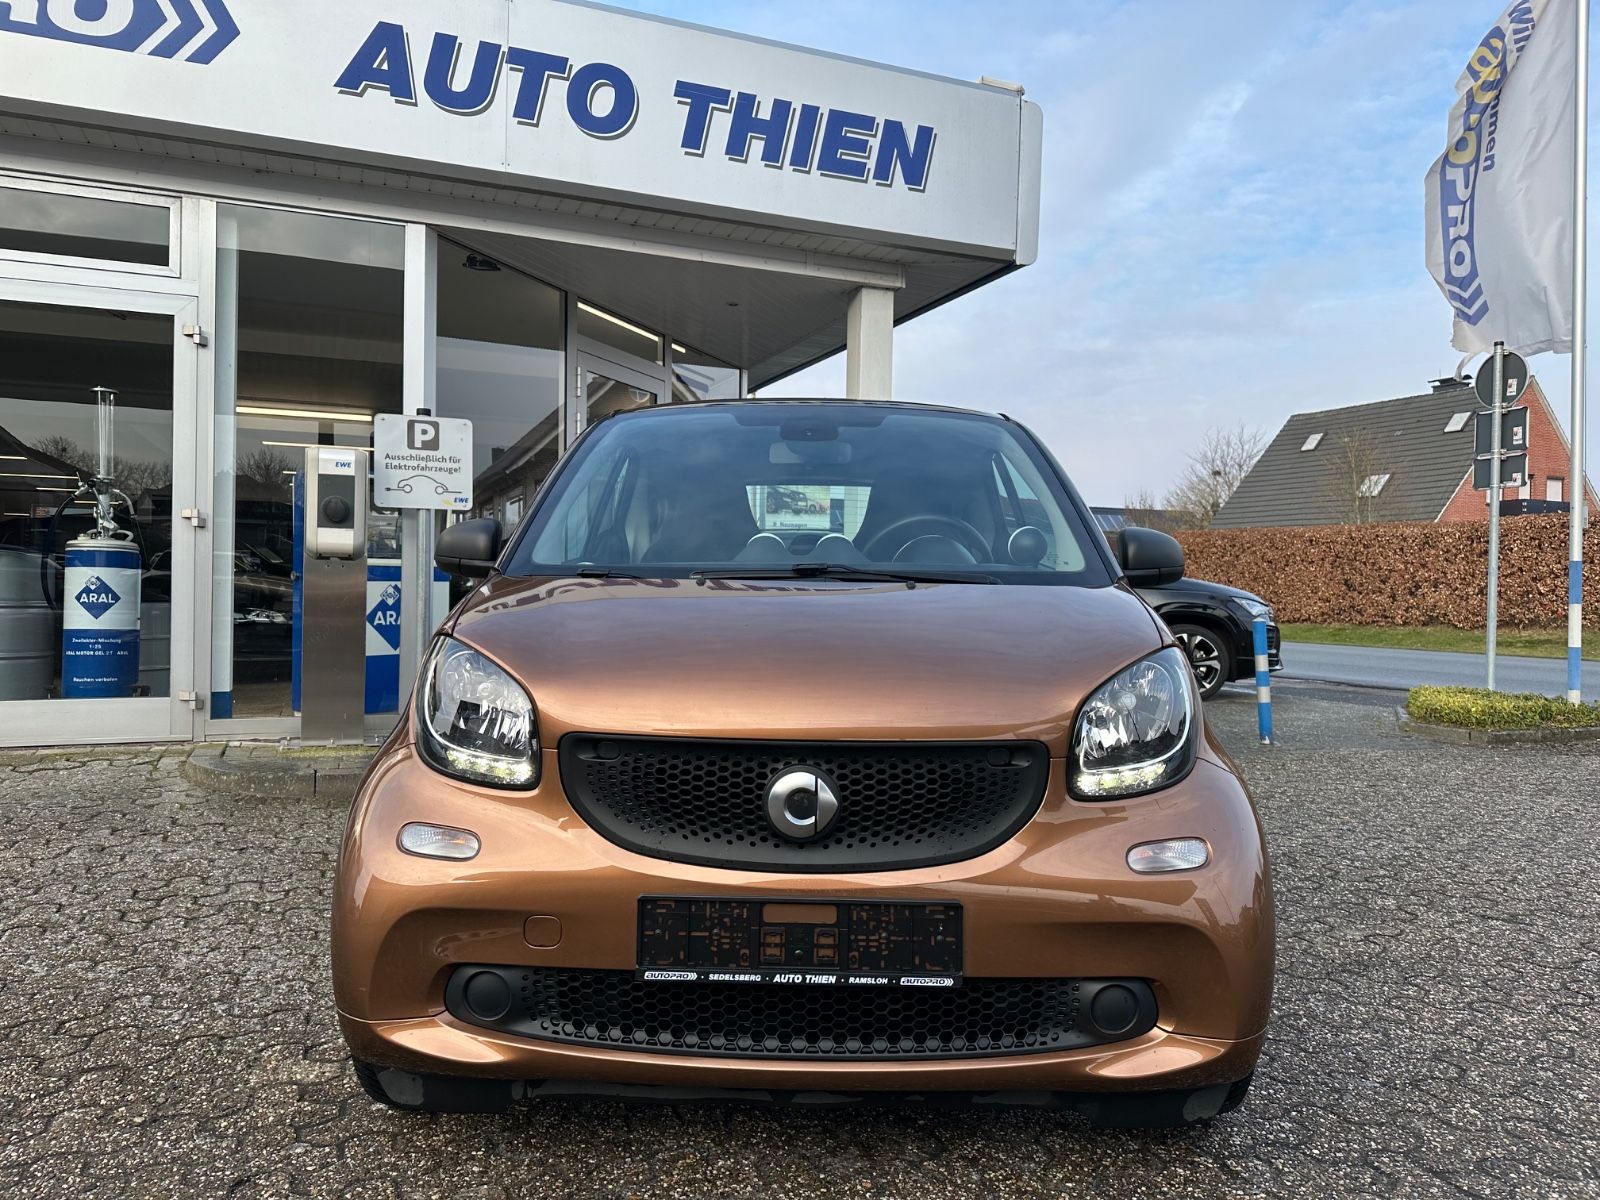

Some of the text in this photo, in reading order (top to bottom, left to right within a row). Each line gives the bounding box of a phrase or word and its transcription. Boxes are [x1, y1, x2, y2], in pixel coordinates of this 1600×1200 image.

[333, 21, 936, 190] AUTO THIEN
[414, 422, 436, 449] P
[385, 453, 461, 464] Ausschließlich für
[385, 463, 461, 475] Elektrofahrzeuge!
[80, 593, 116, 603] ARAL
[373, 610, 401, 625] AR
[708, 973, 761, 981] SEDELSBERG
[773, 974, 802, 983] AUTO
[805, 975, 836, 984] THIEN
